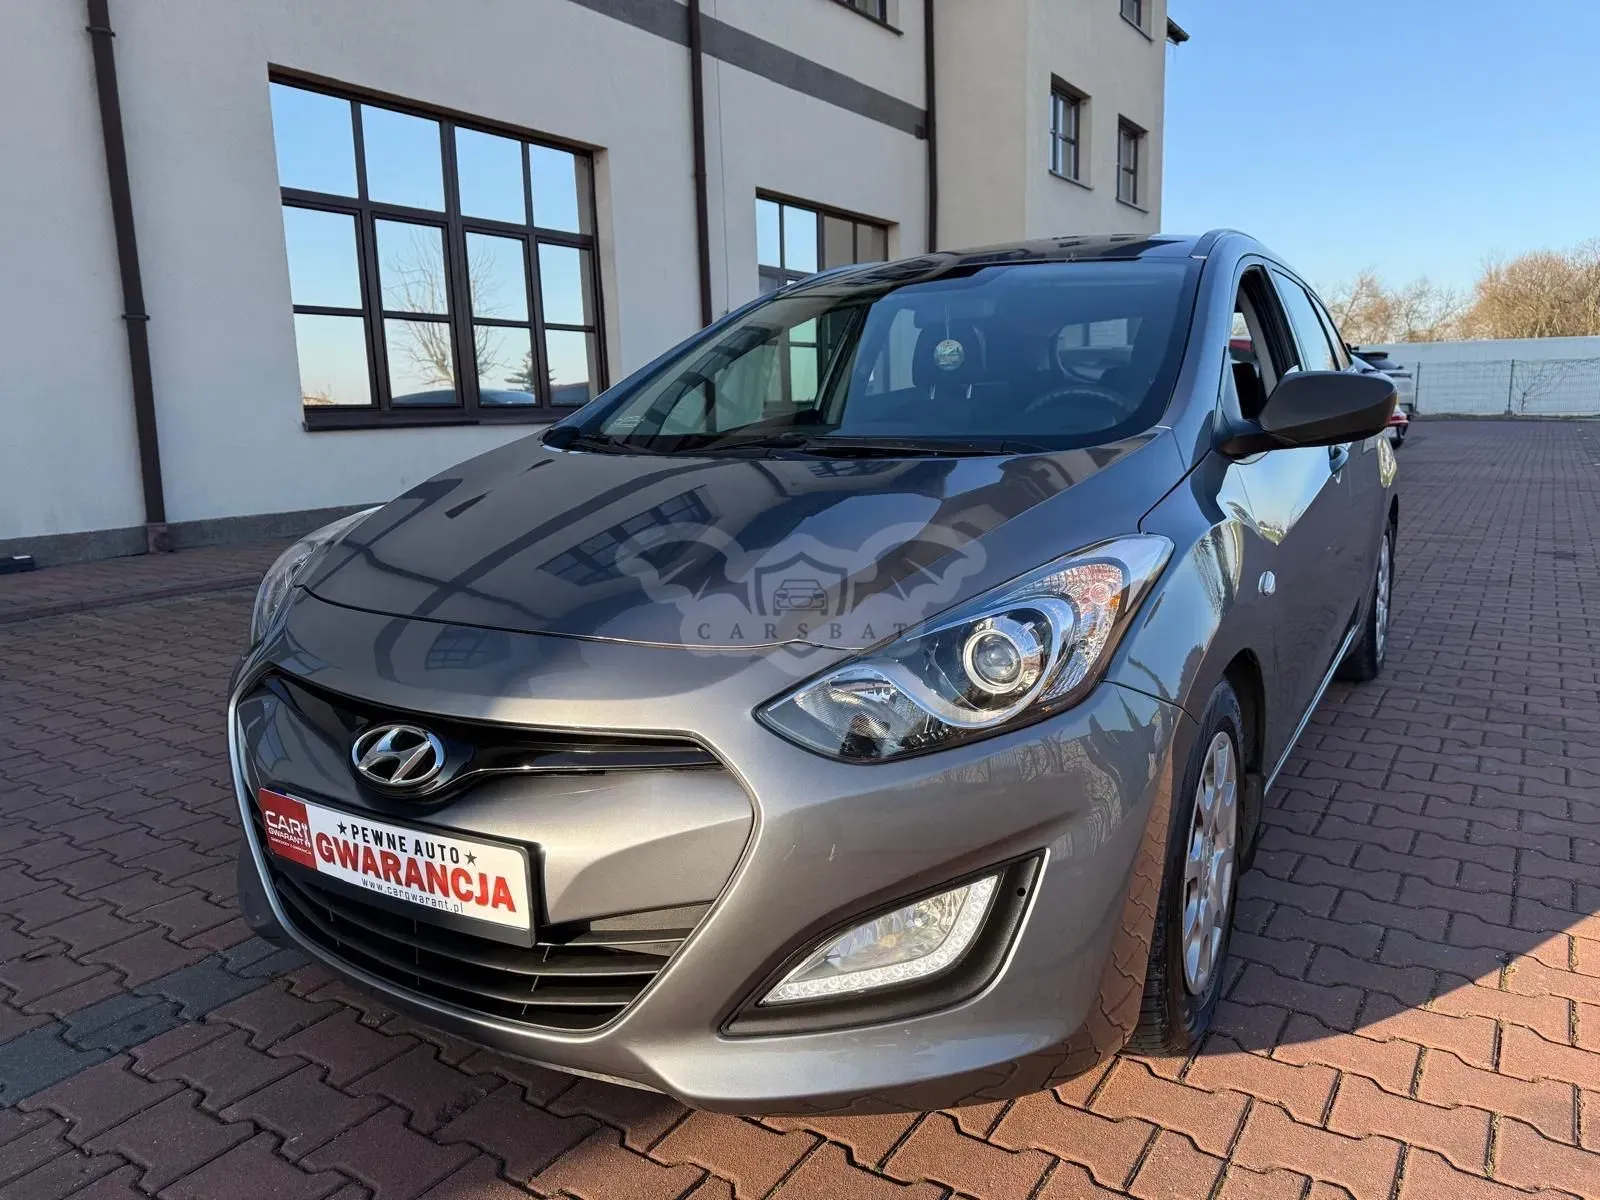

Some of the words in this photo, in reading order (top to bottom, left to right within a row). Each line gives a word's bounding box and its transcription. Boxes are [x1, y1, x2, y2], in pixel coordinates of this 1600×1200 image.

[265, 810, 303, 838] CAR
[268, 827, 304, 845] GWARANT
[351, 824, 408, 853] PEWNE
[414, 840, 460, 864] AUTO
[316, 832, 516, 912] GWARANCJA
